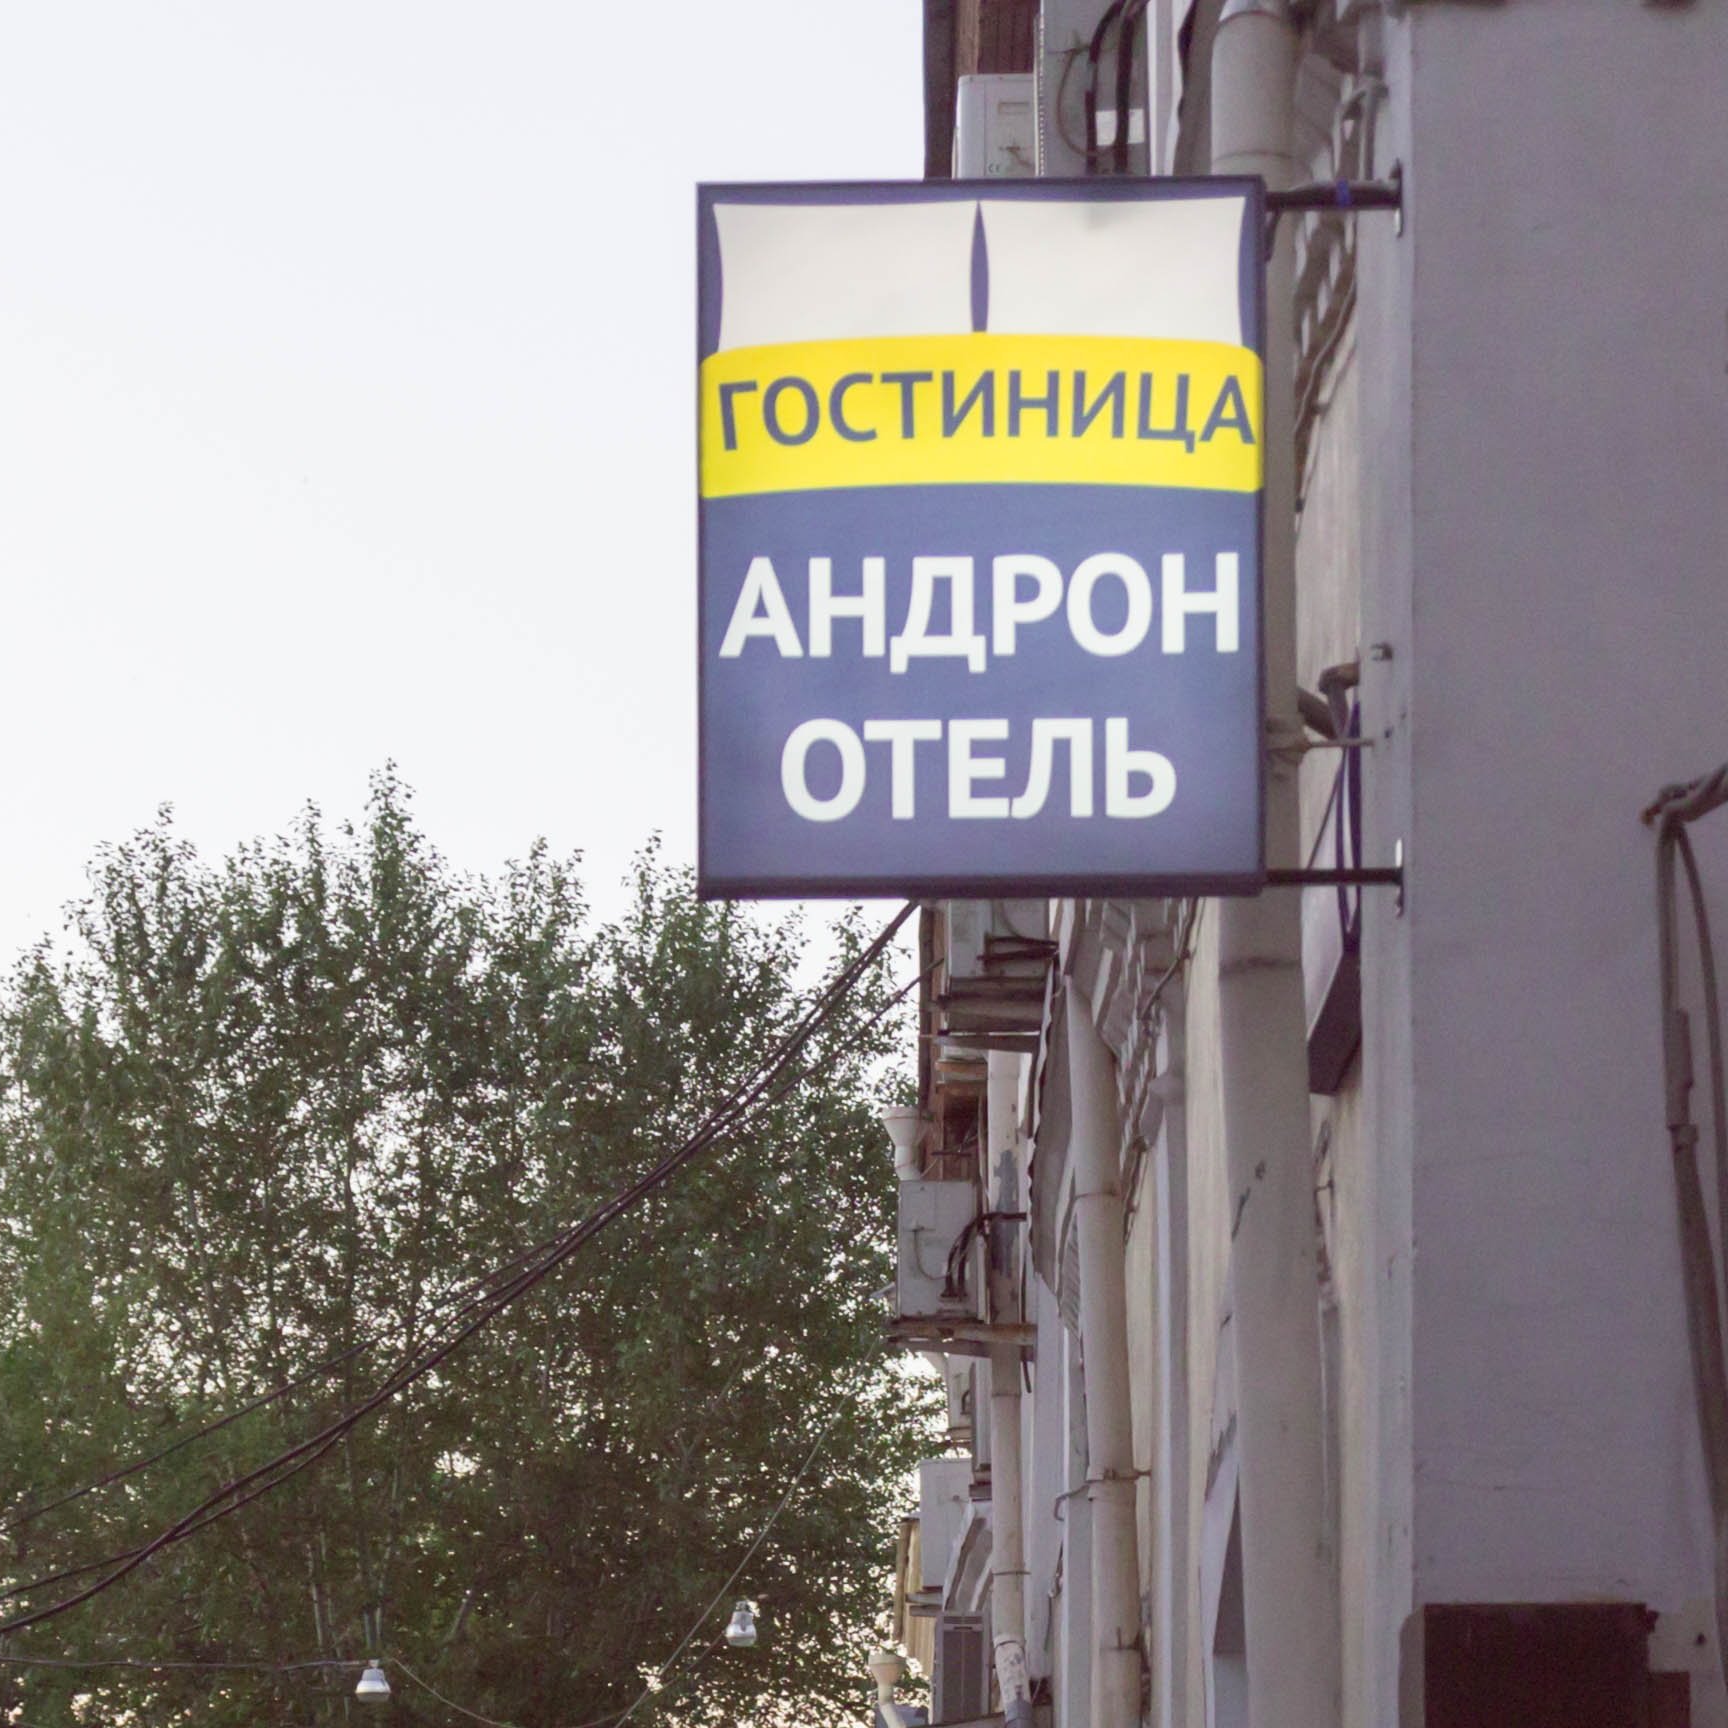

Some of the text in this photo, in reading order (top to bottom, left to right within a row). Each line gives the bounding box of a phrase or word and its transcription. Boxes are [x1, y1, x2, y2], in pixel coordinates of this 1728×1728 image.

[717, 368, 1256, 453] ГОСТИНИЦА
[718, 551, 1239, 674] АНДРОН
[780, 717, 1177, 822] ОТЕЛЬ
